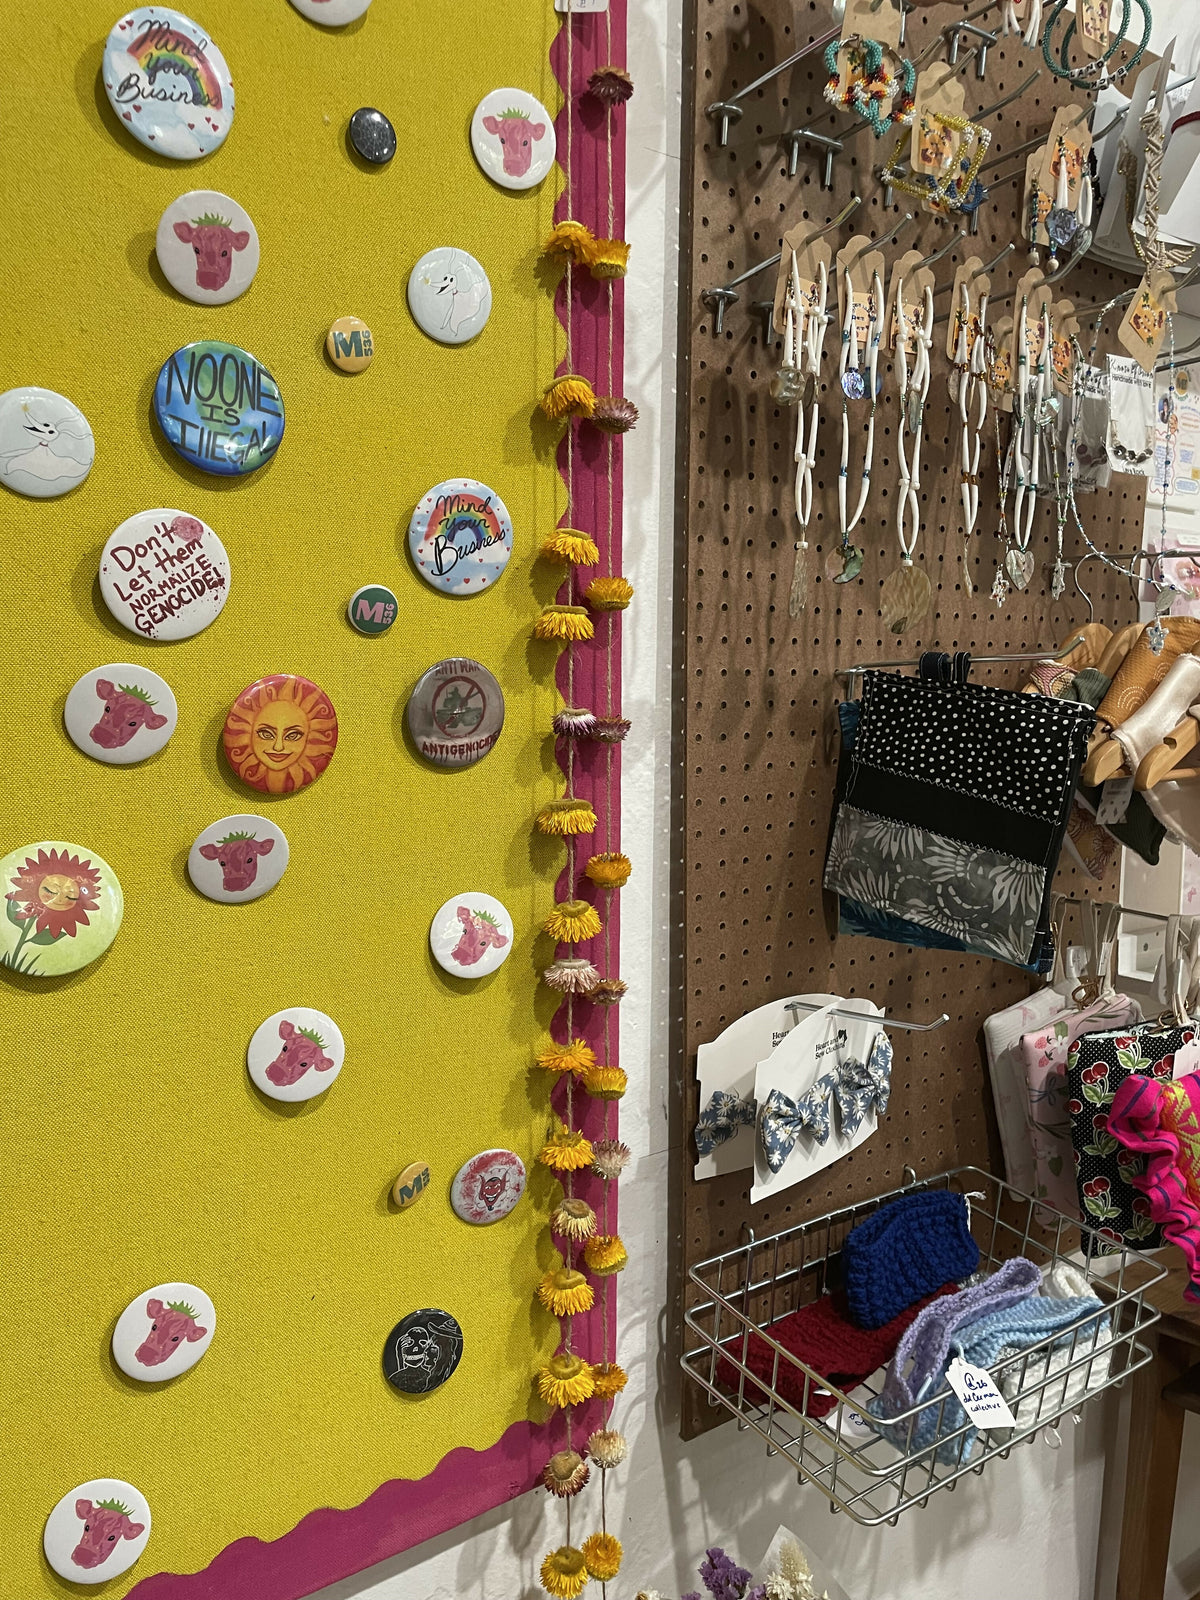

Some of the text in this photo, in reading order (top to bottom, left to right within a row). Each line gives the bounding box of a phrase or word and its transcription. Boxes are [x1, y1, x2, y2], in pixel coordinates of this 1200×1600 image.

[138, 20, 207, 62] Mind
[201, 403, 240, 426] IS
[435, 495, 493, 516] Mind
[110, 522, 175, 572] Don't
[113, 538, 203, 602] Let them
[129, 554, 212, 614] NORMALIZE
[135, 567, 225, 634] GENOCIDE!
